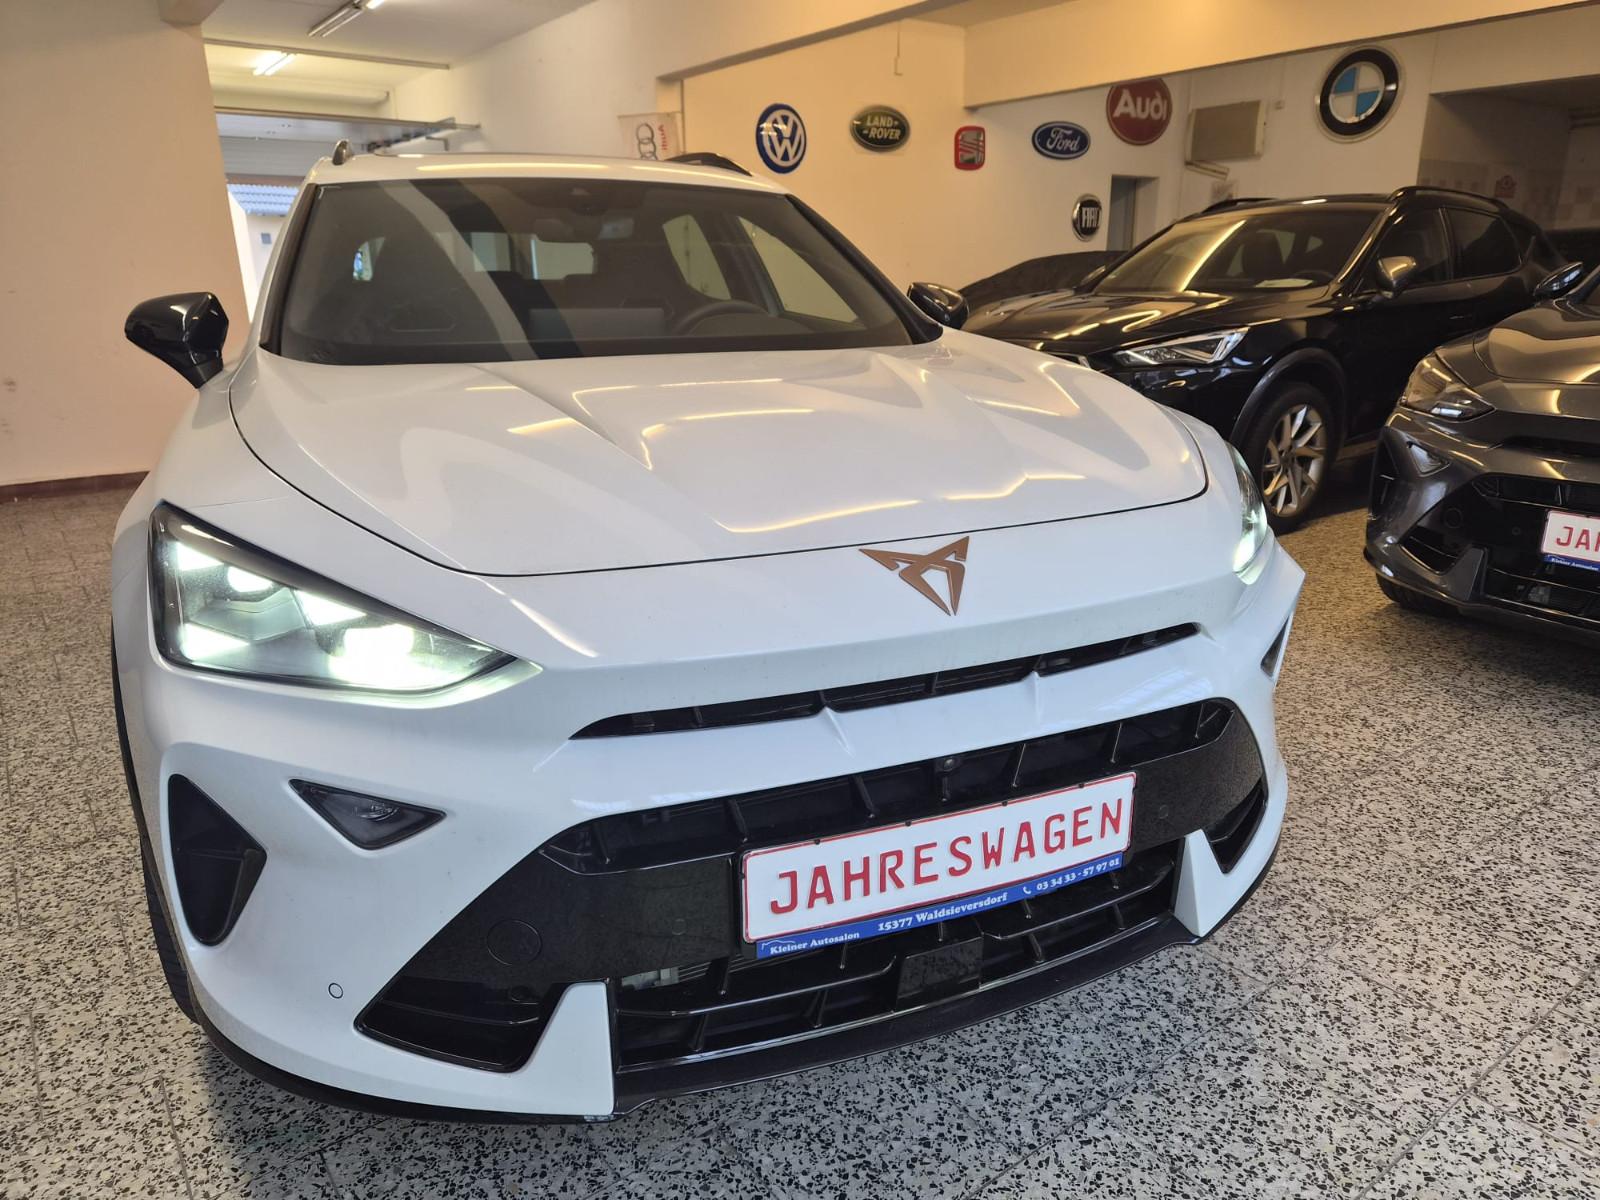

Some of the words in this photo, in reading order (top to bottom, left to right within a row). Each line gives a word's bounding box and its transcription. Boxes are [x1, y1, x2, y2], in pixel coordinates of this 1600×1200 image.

[1112, 88, 1168, 121] Audi
[1046, 127, 1081, 152] Ford
[770, 798, 1122, 914] JAHRESWAGEN
[878, 917, 913, 931] 15377
[915, 892, 1008, 923] Waldsieversdorf
[769, 941, 808, 955] Kleiner
[810, 931, 860, 948] Autosalon
